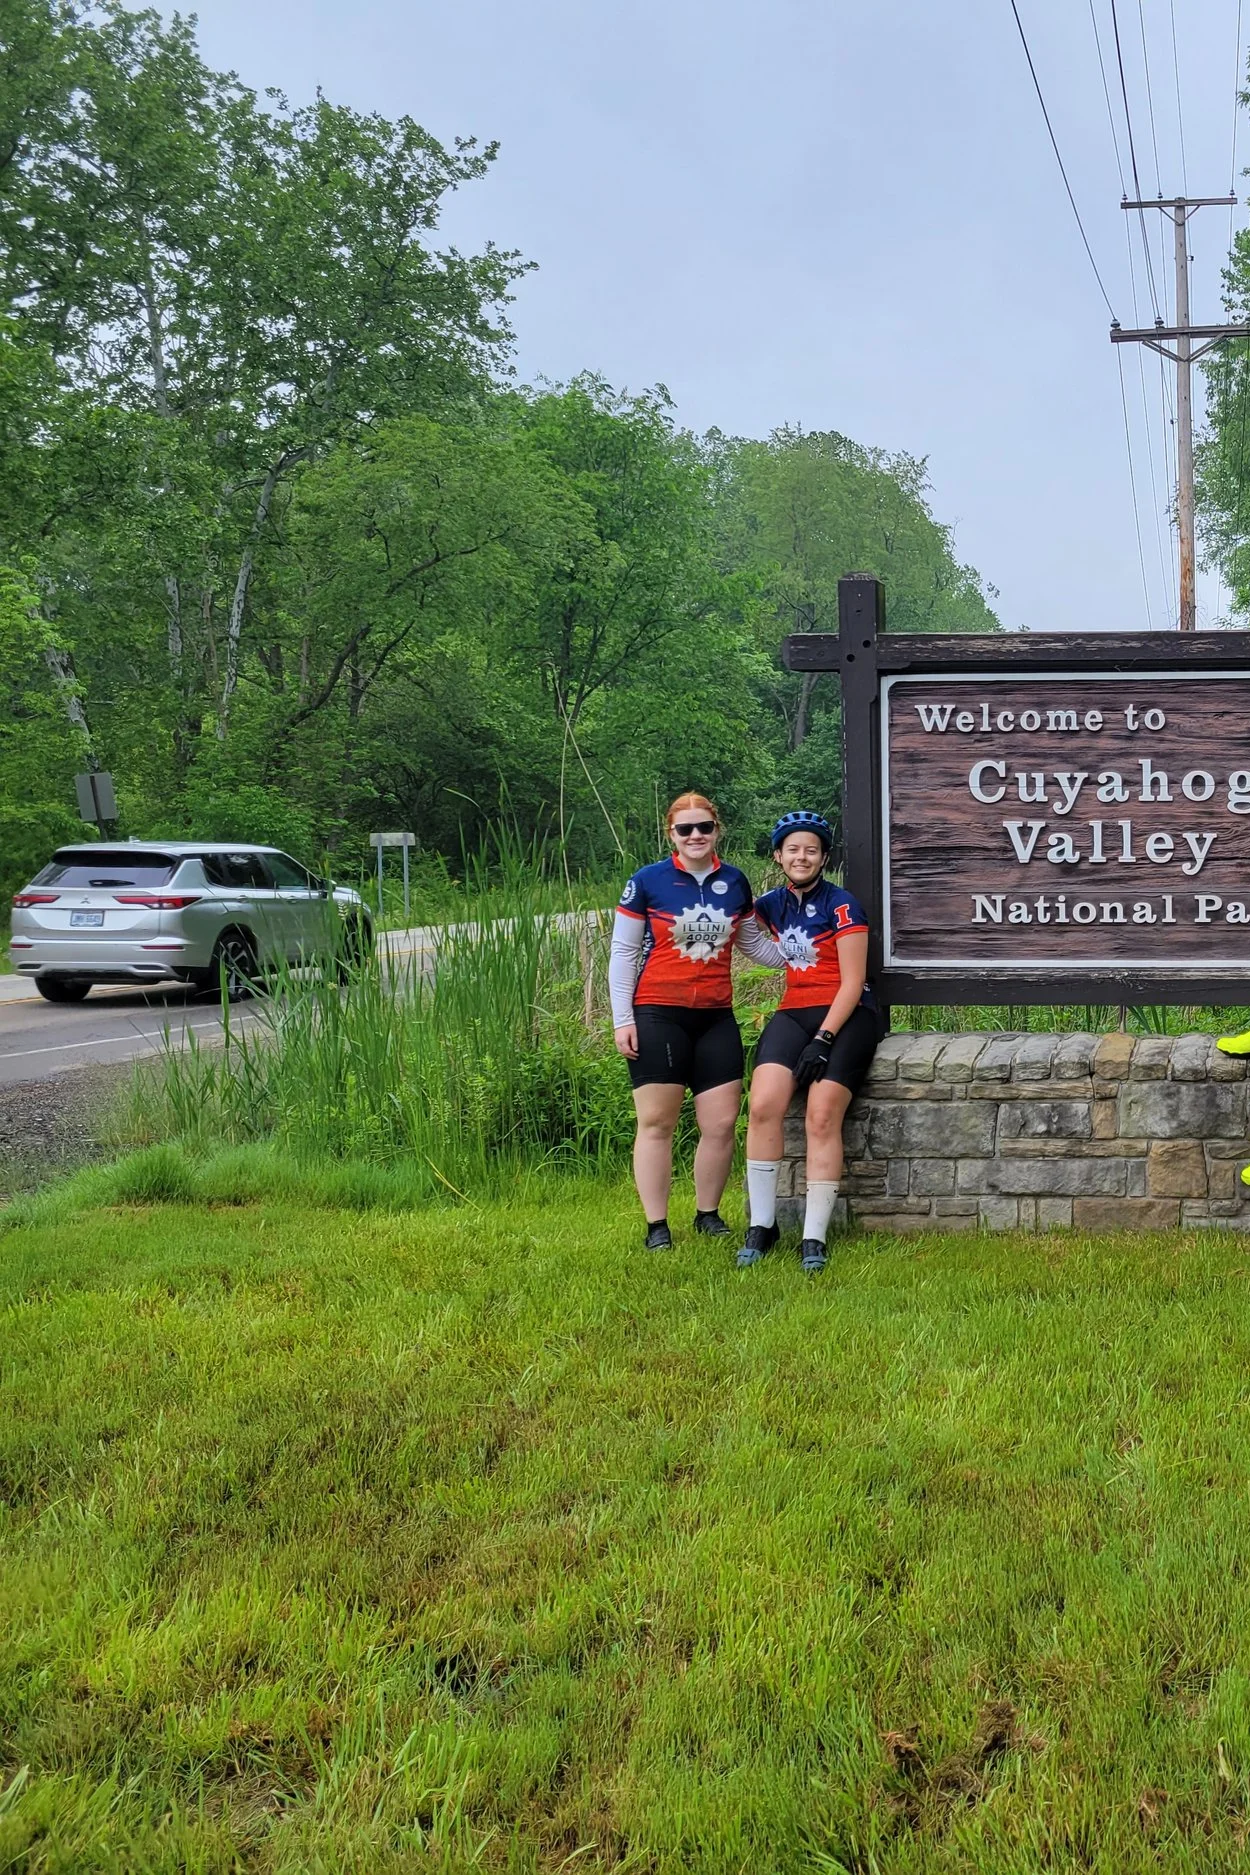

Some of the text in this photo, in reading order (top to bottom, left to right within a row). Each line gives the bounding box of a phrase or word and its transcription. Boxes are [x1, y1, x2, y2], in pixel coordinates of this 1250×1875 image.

[914, 703, 1166, 732] Welcome to
[1001, 819, 1219, 876] Valley
[970, 894, 1177, 924] National
[683, 923, 726, 933] ILLINI
[687, 933, 718, 942] 4000
